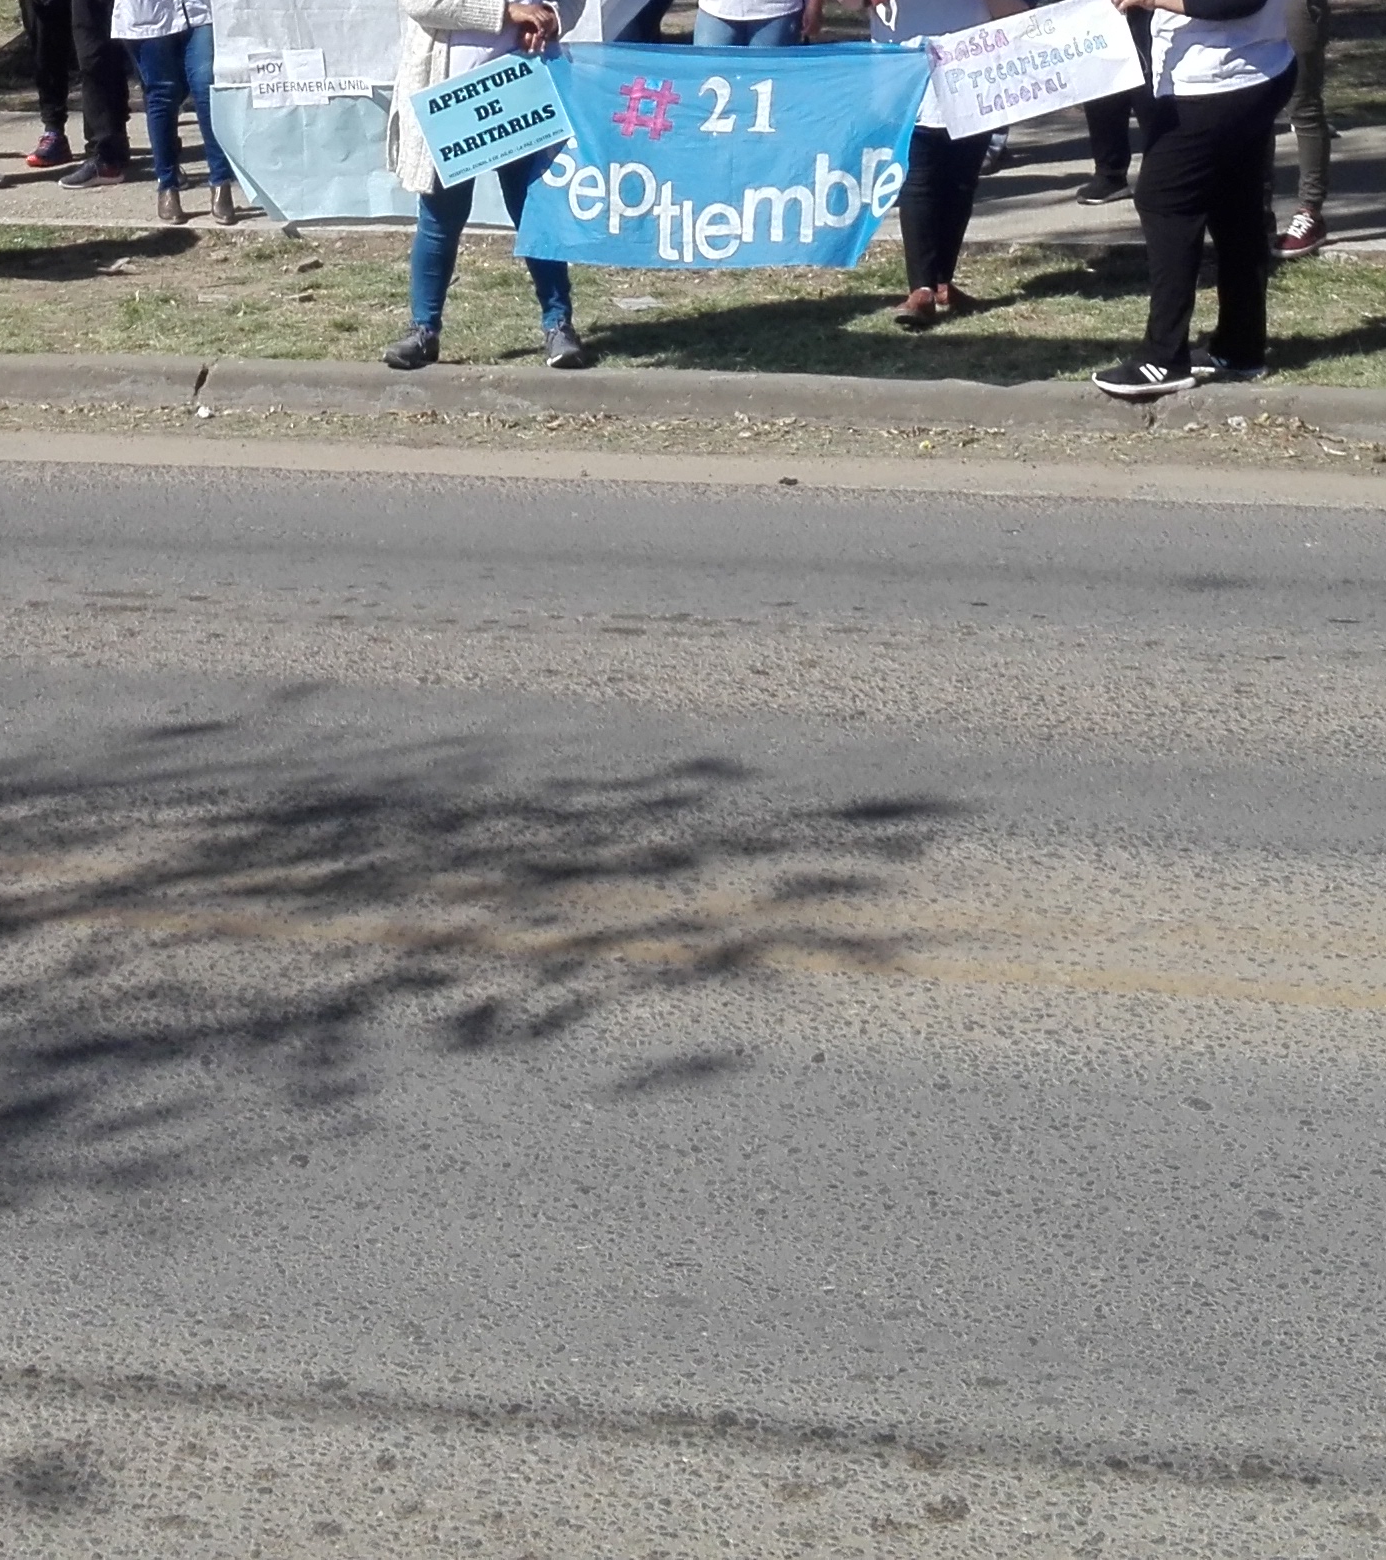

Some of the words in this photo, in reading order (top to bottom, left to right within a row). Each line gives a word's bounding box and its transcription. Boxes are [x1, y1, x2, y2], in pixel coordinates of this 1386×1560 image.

[1026, 14, 1056, 39] de
[256, 62, 283, 74] HOY
[428, 61, 533, 115] APERTURA
[698, 75, 777, 134] 21
[474, 99, 504, 122] DE
[439, 104, 556, 162] PARITARIAS
